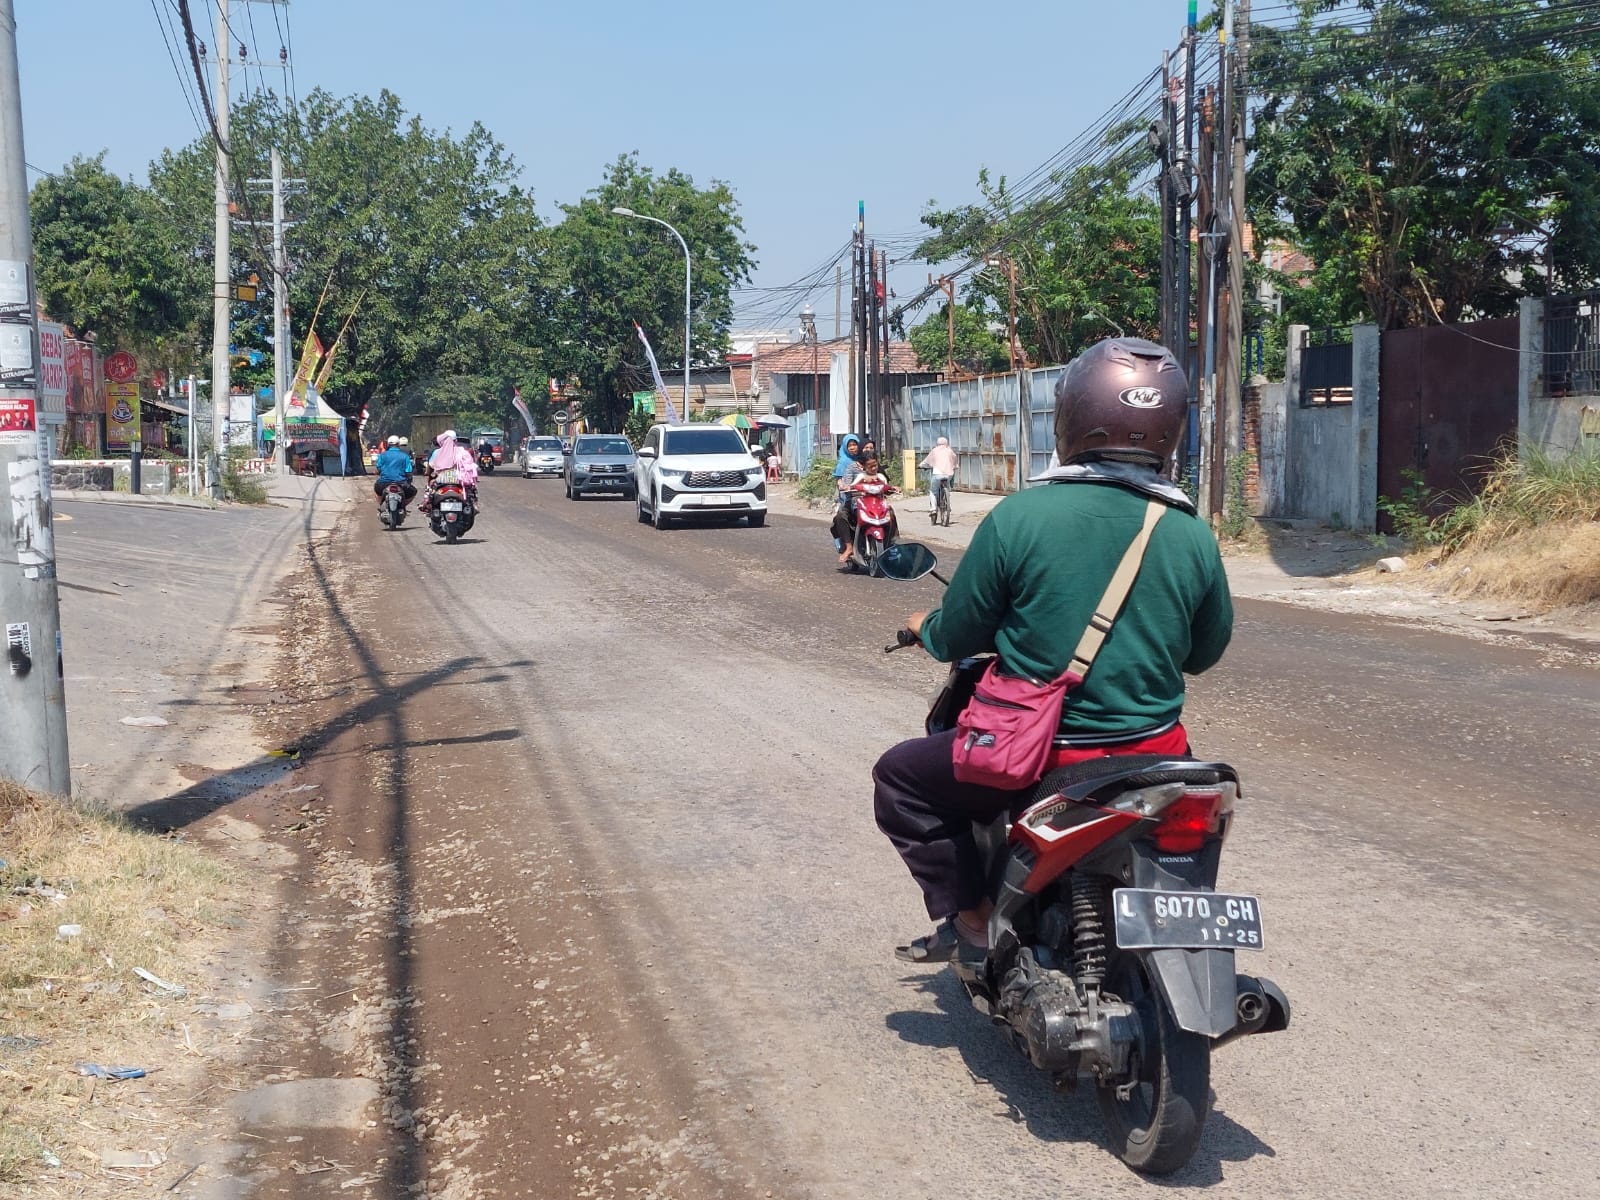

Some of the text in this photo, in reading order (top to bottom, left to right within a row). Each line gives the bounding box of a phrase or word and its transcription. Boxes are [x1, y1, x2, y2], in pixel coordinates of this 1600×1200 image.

[41, 332, 62, 358] BEBAS
[41, 363, 62, 389] PARKIR
[1028, 802, 1067, 828] VARIO
[1158, 856, 1195, 864] HONDA
[1120, 895, 1137, 917] L
[1154, 896, 1211, 919] 6070
